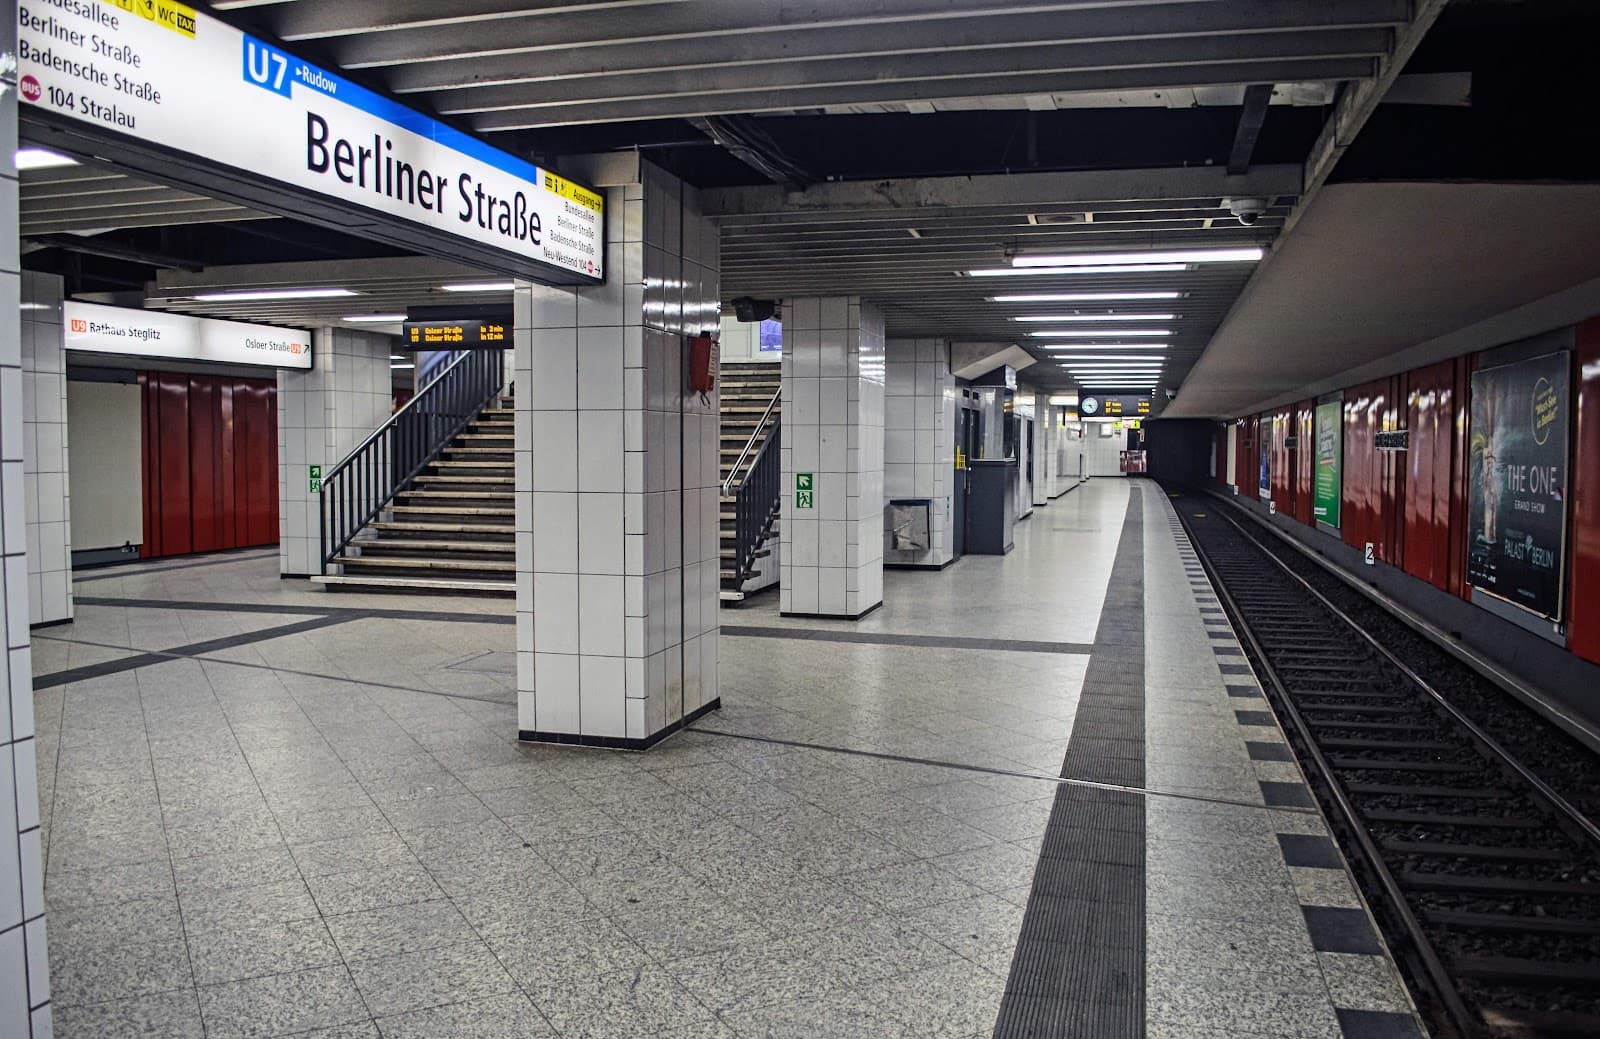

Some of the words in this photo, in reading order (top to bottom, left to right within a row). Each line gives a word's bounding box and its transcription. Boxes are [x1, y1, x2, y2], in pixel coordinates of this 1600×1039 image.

[157, 7, 176, 25] WC
[177, 14, 196, 34] TAXI
[19, 7, 87, 48] Berliner
[92, 34, 141, 69] Straße
[19, 39, 109, 87] Badensche
[114, 73, 161, 104] Straße
[248, 42, 288, 90] U7
[302, 64, 337, 94] Rudow
[22, 81, 41, 96] BUS
[48, 86, 75, 110] 104
[81, 96, 136, 129] Stralau
[307, 110, 448, 214] Berliner
[458, 172, 542, 246] Straße
[573, 188, 595, 210] Ausgang
[557, 215, 578, 234] Berliner
[579, 224, 595, 240] Straße
[550, 229, 578, 249] Badensche
[579, 240, 595, 256] Straße
[543, 246, 578, 268] Neu-Westend
[72, 320, 86, 332] U9
[89, 322, 126, 337] Rathaus
[128, 327, 161, 341] Steglitz
[245, 338, 267, 350] Osloer
[269, 341, 290, 353] Straße
[1507, 464, 1526, 492] THE
[1529, 465, 1557, 495] ONE
[1531, 502, 1546, 514] SHOW
[1366, 546, 1374, 560] 2
[1532, 546, 1554, 568] BERLIN
